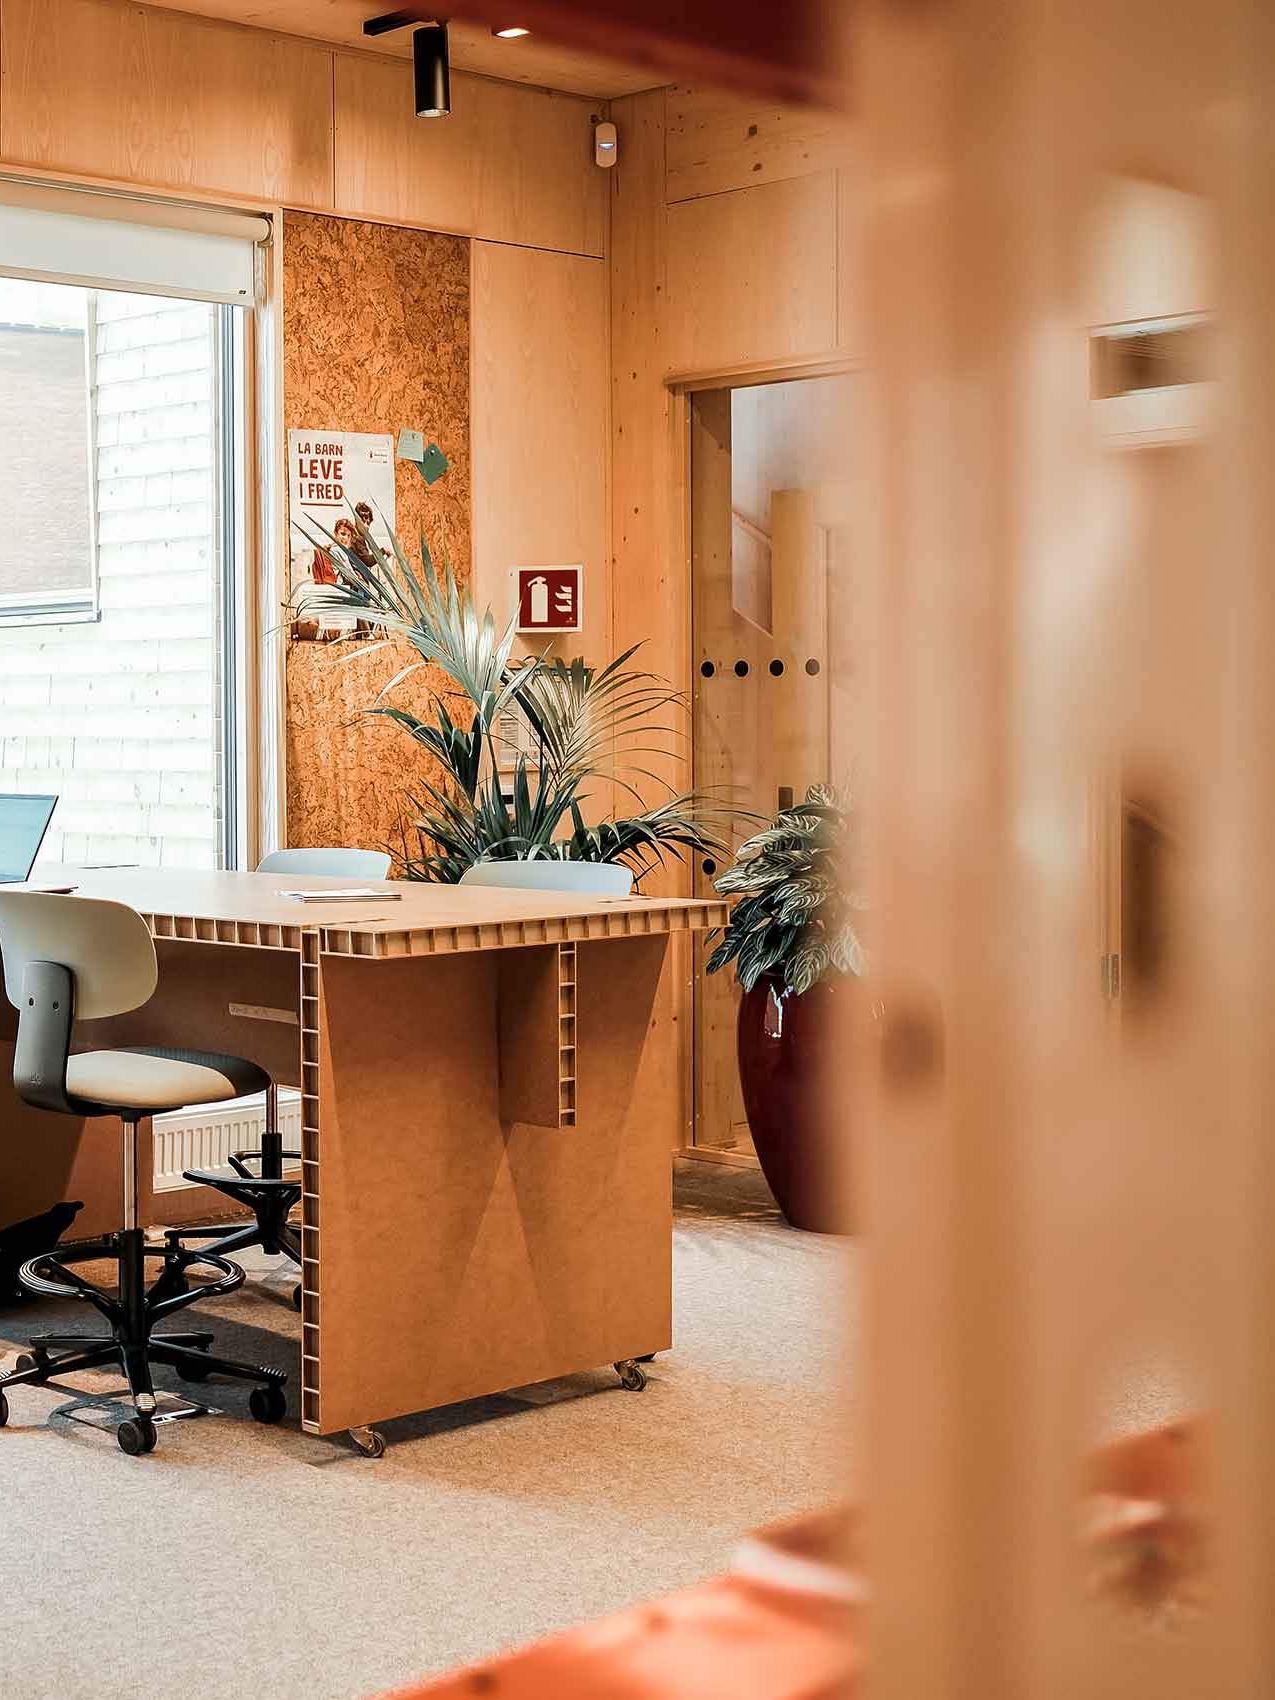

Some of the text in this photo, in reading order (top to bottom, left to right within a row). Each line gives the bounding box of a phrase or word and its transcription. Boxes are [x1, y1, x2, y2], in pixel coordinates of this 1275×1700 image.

[298, 442, 343, 456] LA BARN
[299, 458, 343, 480] LEVE
[308, 483, 344, 500] FRED
